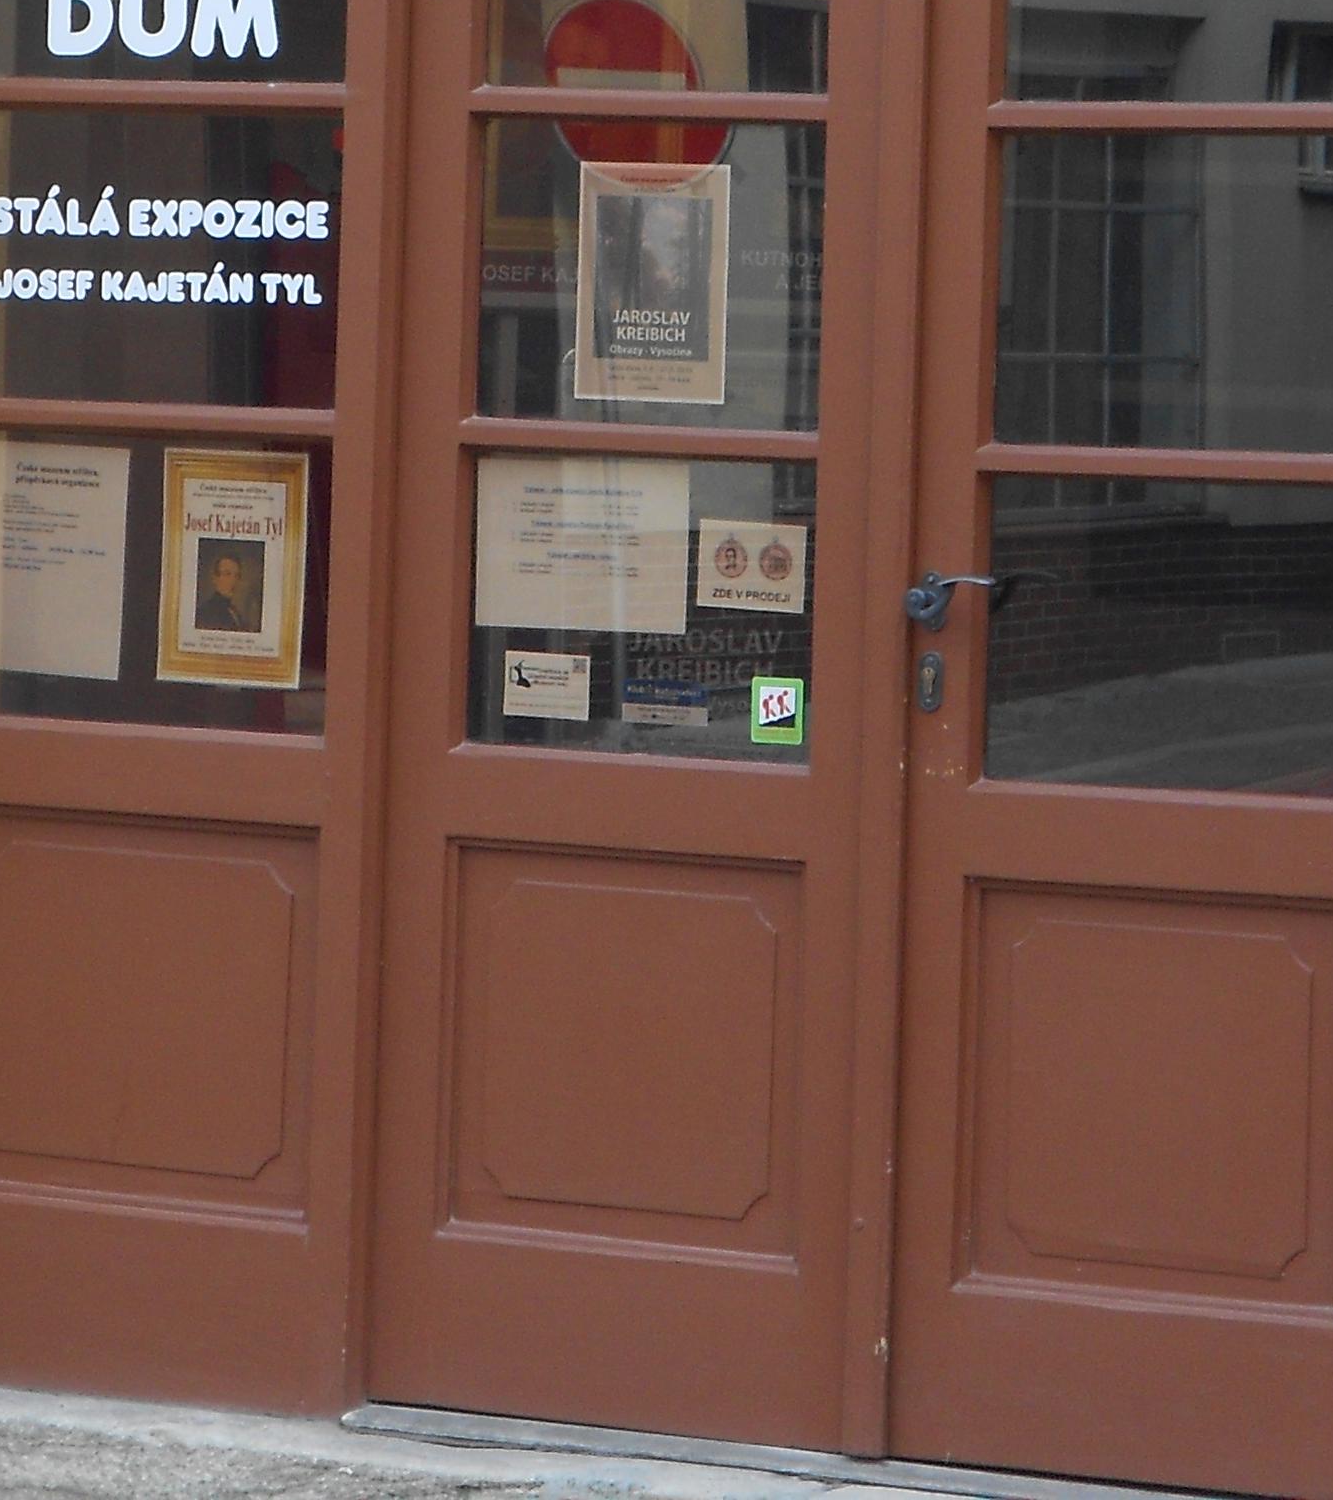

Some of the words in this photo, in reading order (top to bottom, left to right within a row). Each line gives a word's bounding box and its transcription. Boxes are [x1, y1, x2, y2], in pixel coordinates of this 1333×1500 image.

[127, 198, 330, 240] EXPOZICE
[100, 260, 255, 304] KAJETÁN
[259, 272, 323, 306] TYL
[612, 308, 691, 326] JAROSLAV
[616, 325, 687, 342] KREIBICH
[185, 512, 214, 532] Josef
[215, 513, 261, 539] Kajetán
[263, 516, 283, 541] Tyl
[712, 588, 733, 598] ZDE
[735, 589, 743, 599] V
